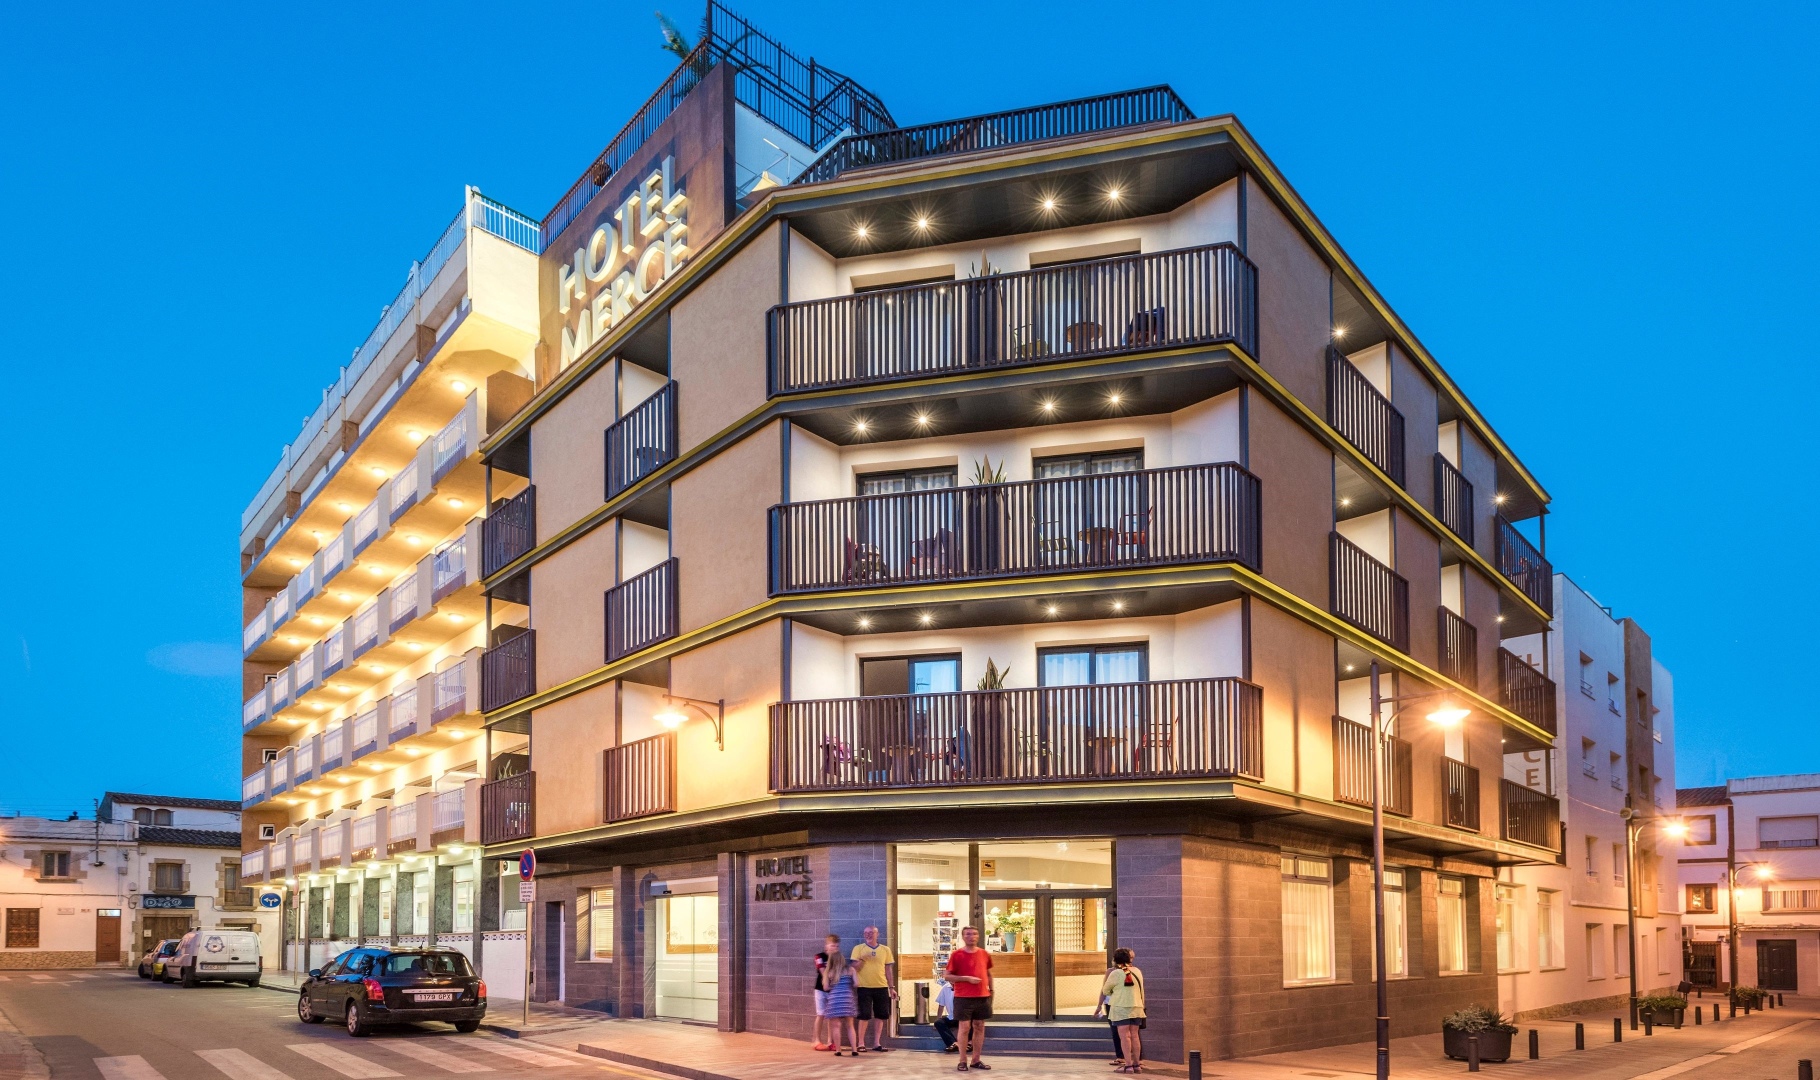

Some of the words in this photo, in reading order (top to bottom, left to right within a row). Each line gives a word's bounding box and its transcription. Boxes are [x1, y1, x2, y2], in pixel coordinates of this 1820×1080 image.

[559, 155, 688, 315] HOTEL
[755, 855, 813, 877] HOTEL
[755, 875, 813, 901] MERCÈ
